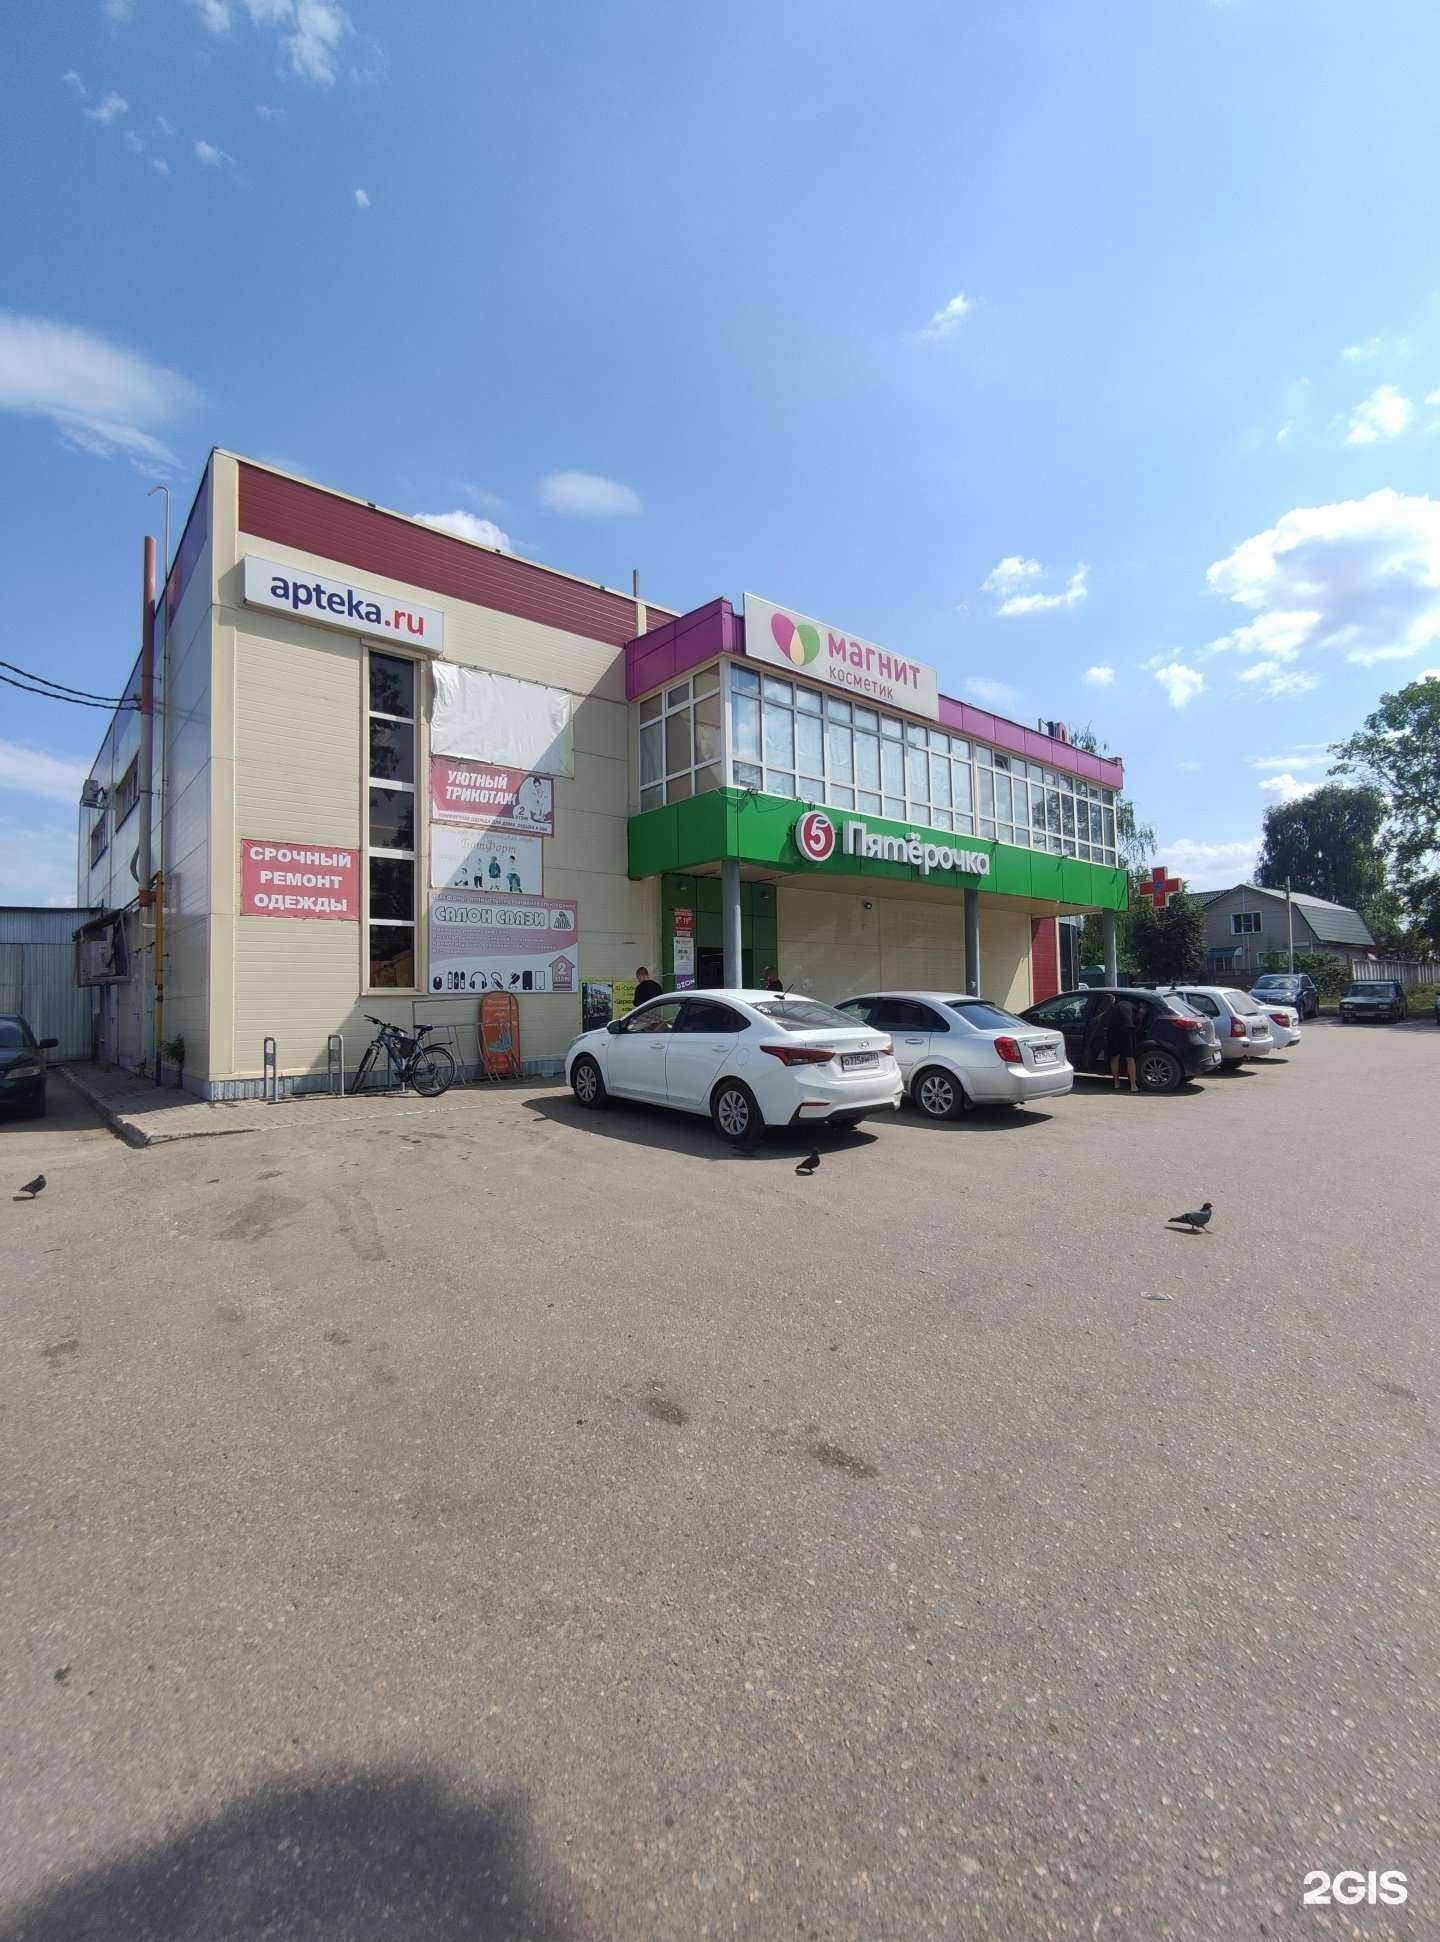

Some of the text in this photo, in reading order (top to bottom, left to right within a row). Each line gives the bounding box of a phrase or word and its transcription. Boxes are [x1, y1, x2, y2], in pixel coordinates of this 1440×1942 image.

[270, 576, 424, 635] apteka.ru
[447, 770, 508, 789] УЮТНЫЙ
[518, 806, 525, 815] 2
[809, 816, 990, 876] 5 Пятёрочка
[250, 846, 351, 867] СРОЧНЫЙ
[260, 870, 343, 889] РЕМОНТ
[254, 893, 348, 912] ОДЕЖДЫ
[434, 905, 546, 927] САЛОН СВЯЗИ
[558, 962, 567, 976] 2
